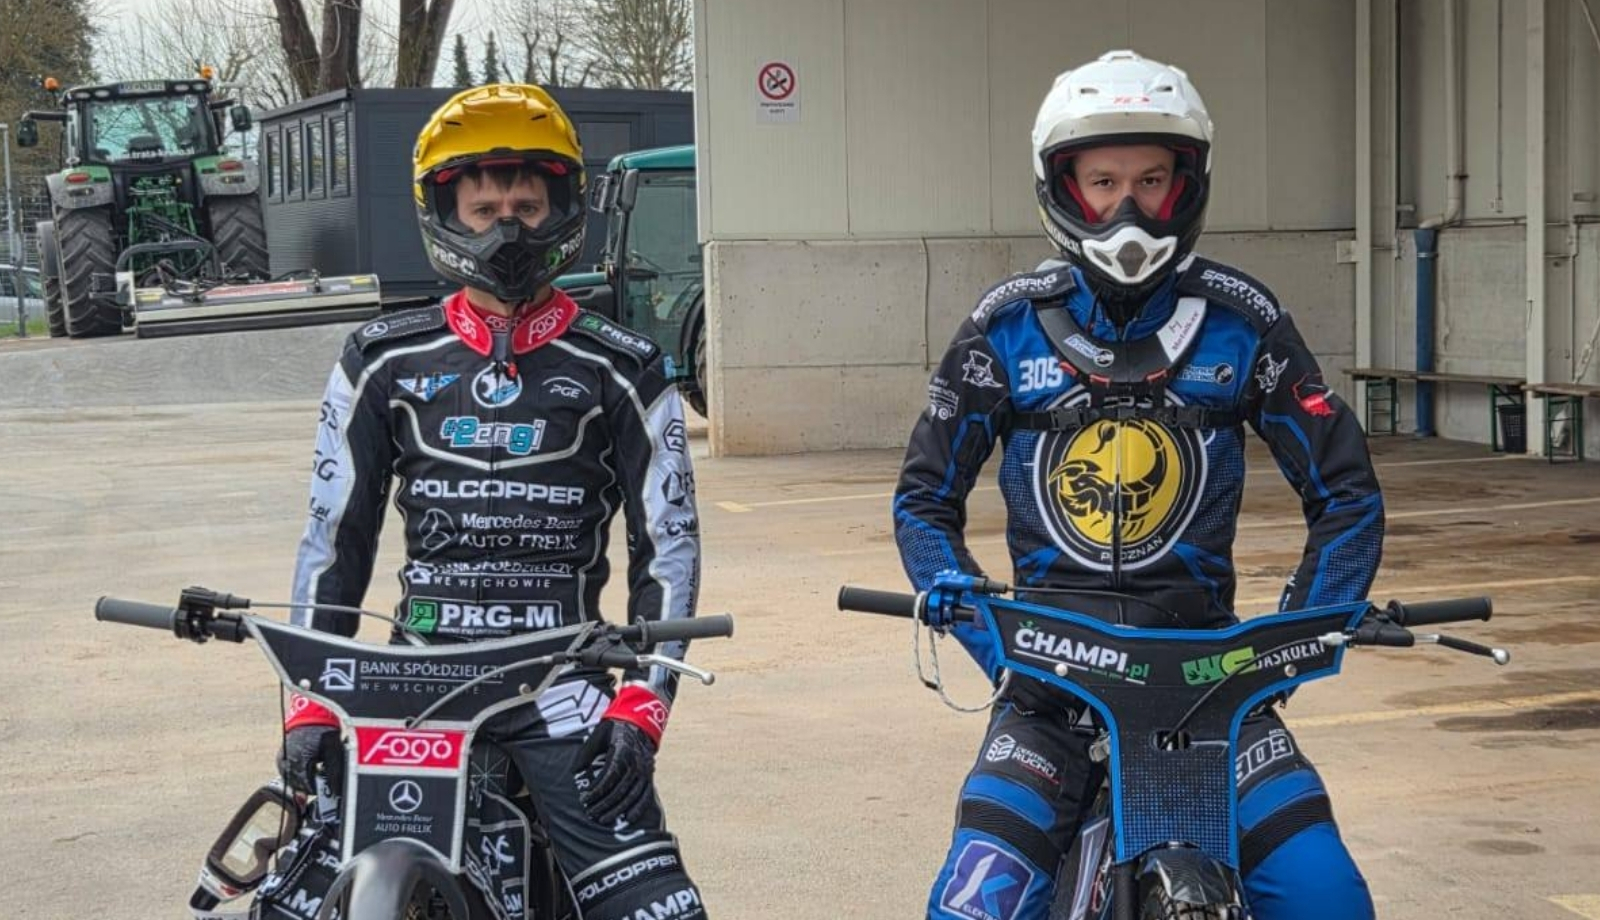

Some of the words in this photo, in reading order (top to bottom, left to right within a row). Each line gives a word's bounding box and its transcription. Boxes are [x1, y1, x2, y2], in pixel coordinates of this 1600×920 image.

[1200, 269, 1280, 324] SPORTGAN
[600, 323, 652, 353] PRG-M
[1017, 356, 1066, 393] 305
[550, 384, 582, 399] PGE
[411, 479, 585, 504] POLCOPPER
[460, 534, 513, 548] AUTO
[440, 603, 555, 628] PRG-M
[360, 661, 400, 675] BANK
[360, 683, 381, 692] WE
